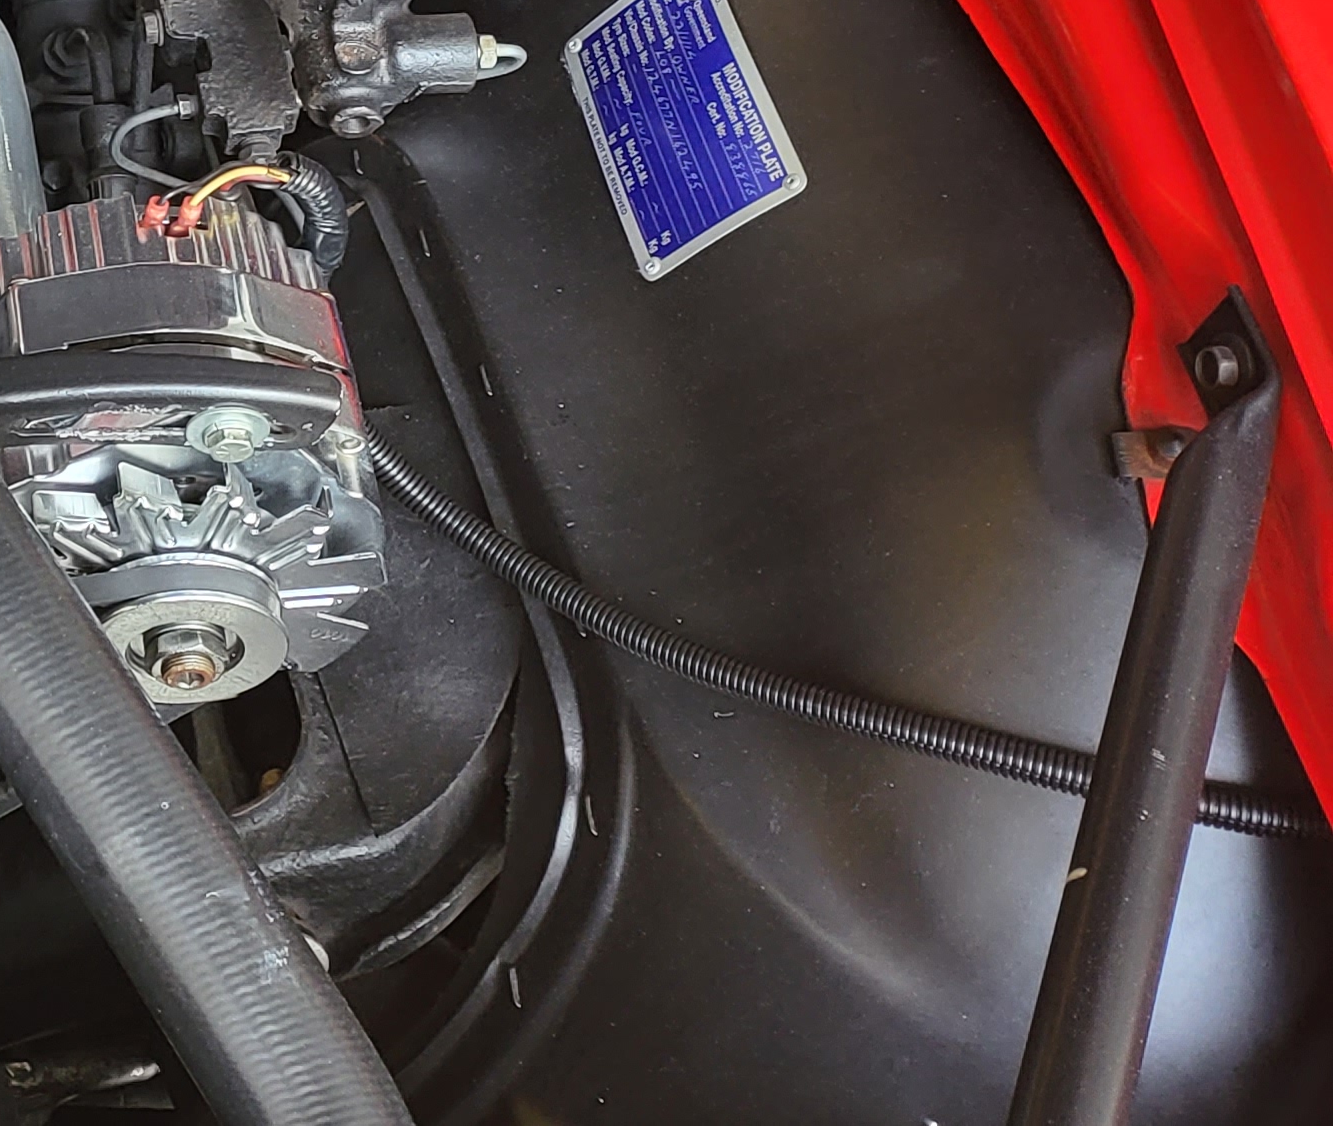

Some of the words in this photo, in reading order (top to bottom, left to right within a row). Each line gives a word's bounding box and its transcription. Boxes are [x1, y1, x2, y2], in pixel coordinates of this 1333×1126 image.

[682, 3, 707, 50] Government
[670, 51, 700, 109] OWNER
[582, 96, 592, 114] THIS
[710, 69, 740, 124] Accreditation
[731, 119, 746, 139] No:
[588, 113, 599, 138] PLATE
[721, 60, 767, 146] MODIFICATION
[756, 140, 784, 183] PLATE
[595, 137, 605, 153] NOT
[601, 153, 610, 166] TO
[605, 165, 614, 178] BE
[610, 177, 629, 217] REMOVED
